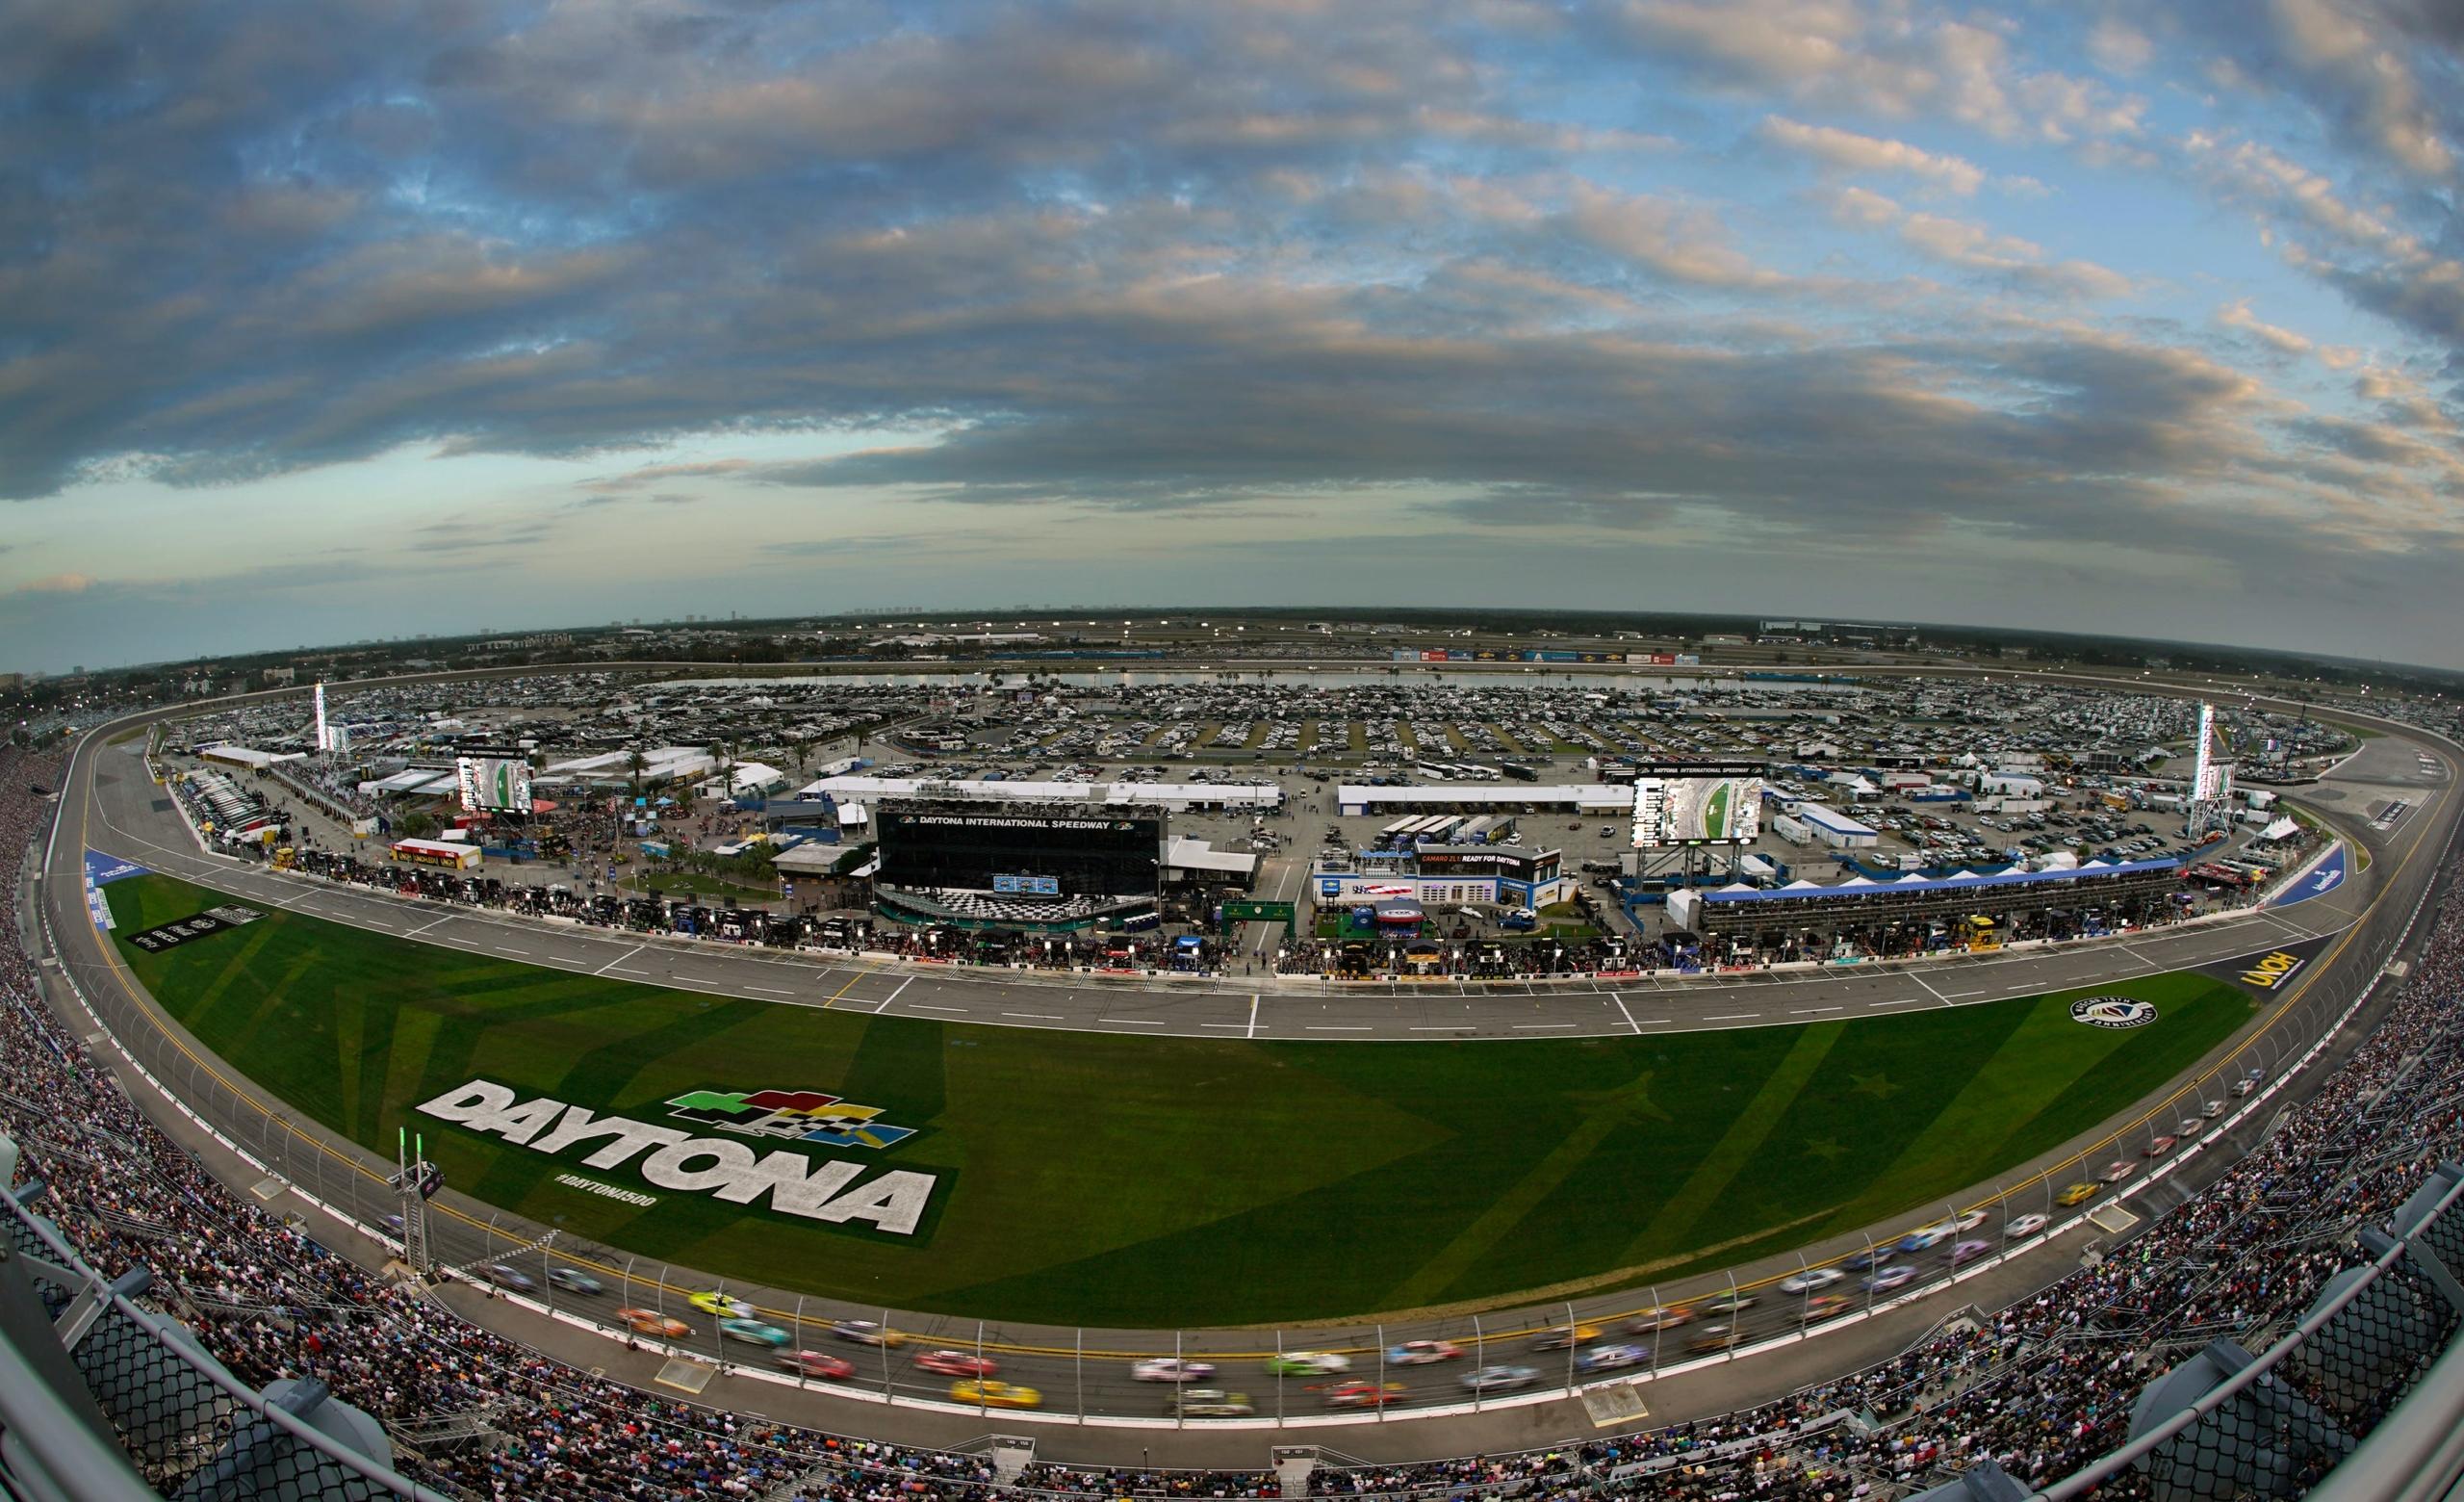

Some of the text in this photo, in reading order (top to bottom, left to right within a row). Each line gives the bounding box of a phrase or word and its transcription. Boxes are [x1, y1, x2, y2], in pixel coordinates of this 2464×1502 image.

[919, 816, 1111, 830] DAYTONA INTERNATIONAL SPEEDWAY
[1497, 855, 1521, 867] DAYTONA
[151, 930, 180, 944] GEICO
[2237, 951, 2298, 987] UNOH
[415, 1078, 938, 1235] DAYTONA
[554, 1173, 657, 1207] #DAYTONA500
